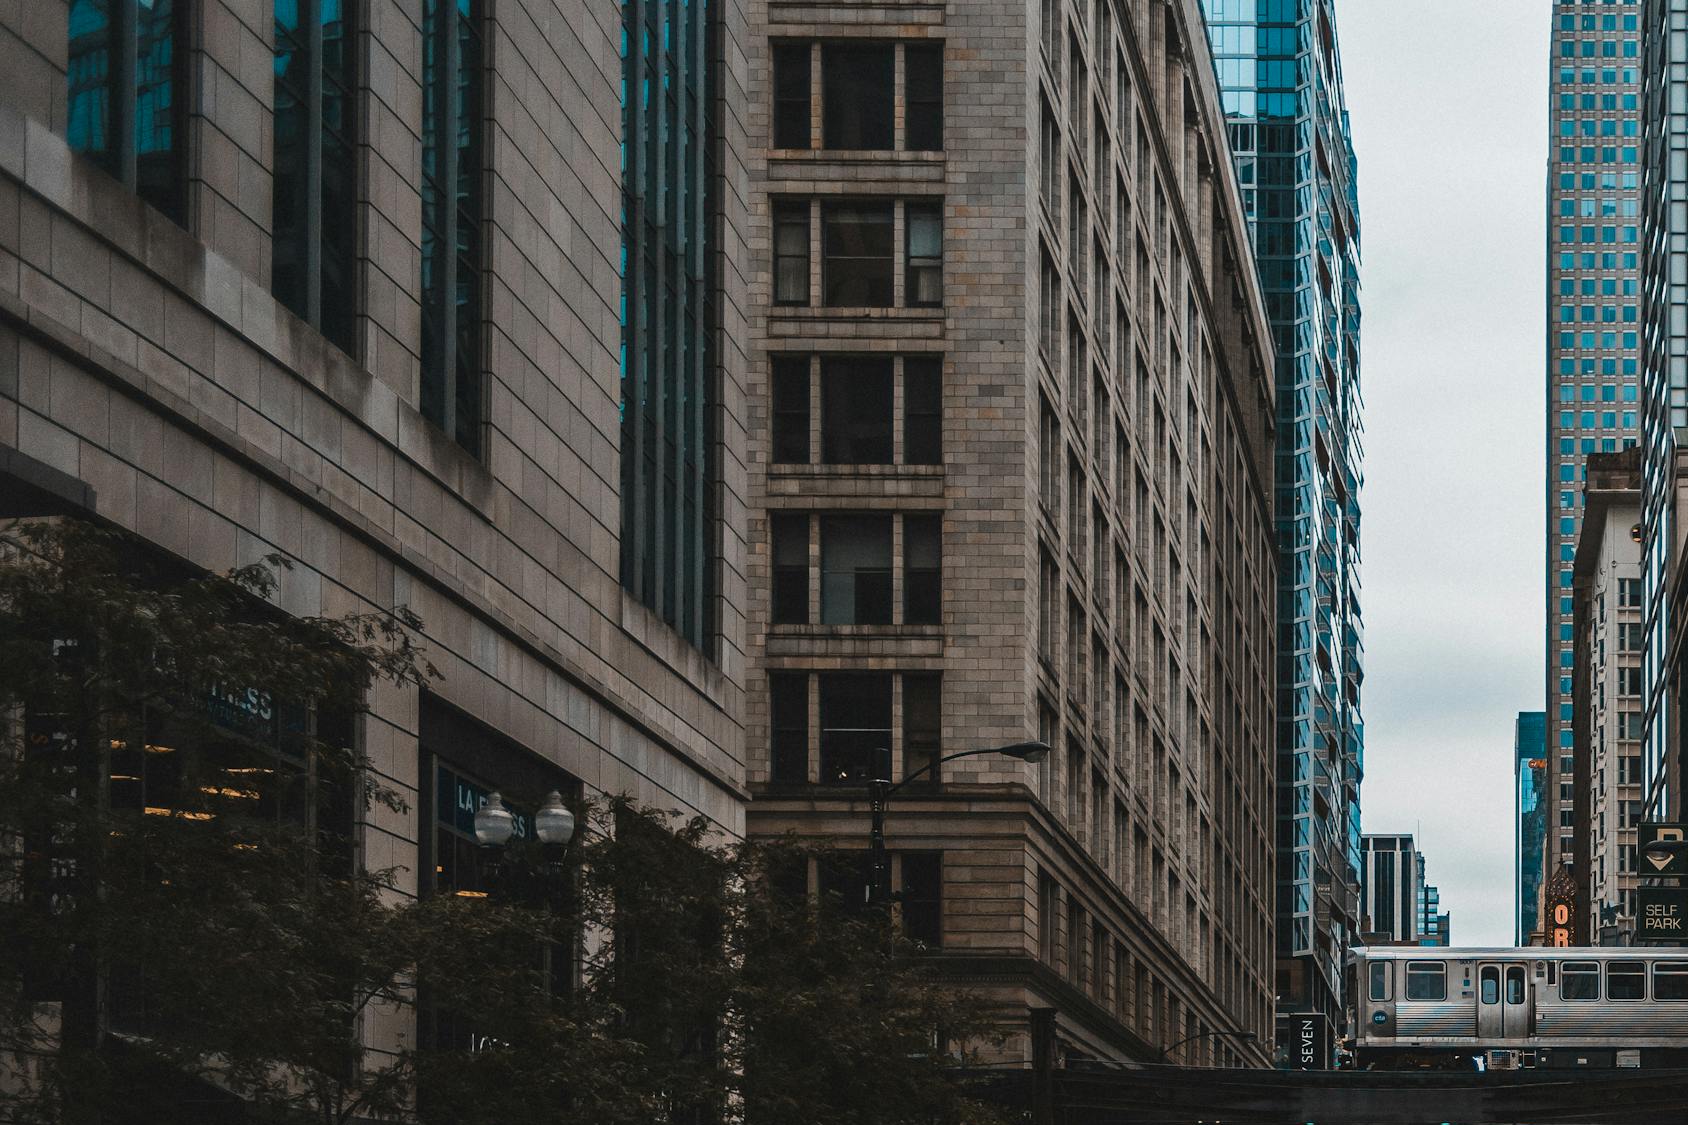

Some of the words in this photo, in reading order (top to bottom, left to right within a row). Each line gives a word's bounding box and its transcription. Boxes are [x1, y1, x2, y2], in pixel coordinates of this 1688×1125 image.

[459, 785, 474, 814] LA
[1645, 904, 1678, 917] SELF
[1645, 918, 1682, 930] PARK
[1302, 1020, 1314, 1063] SEVEN
